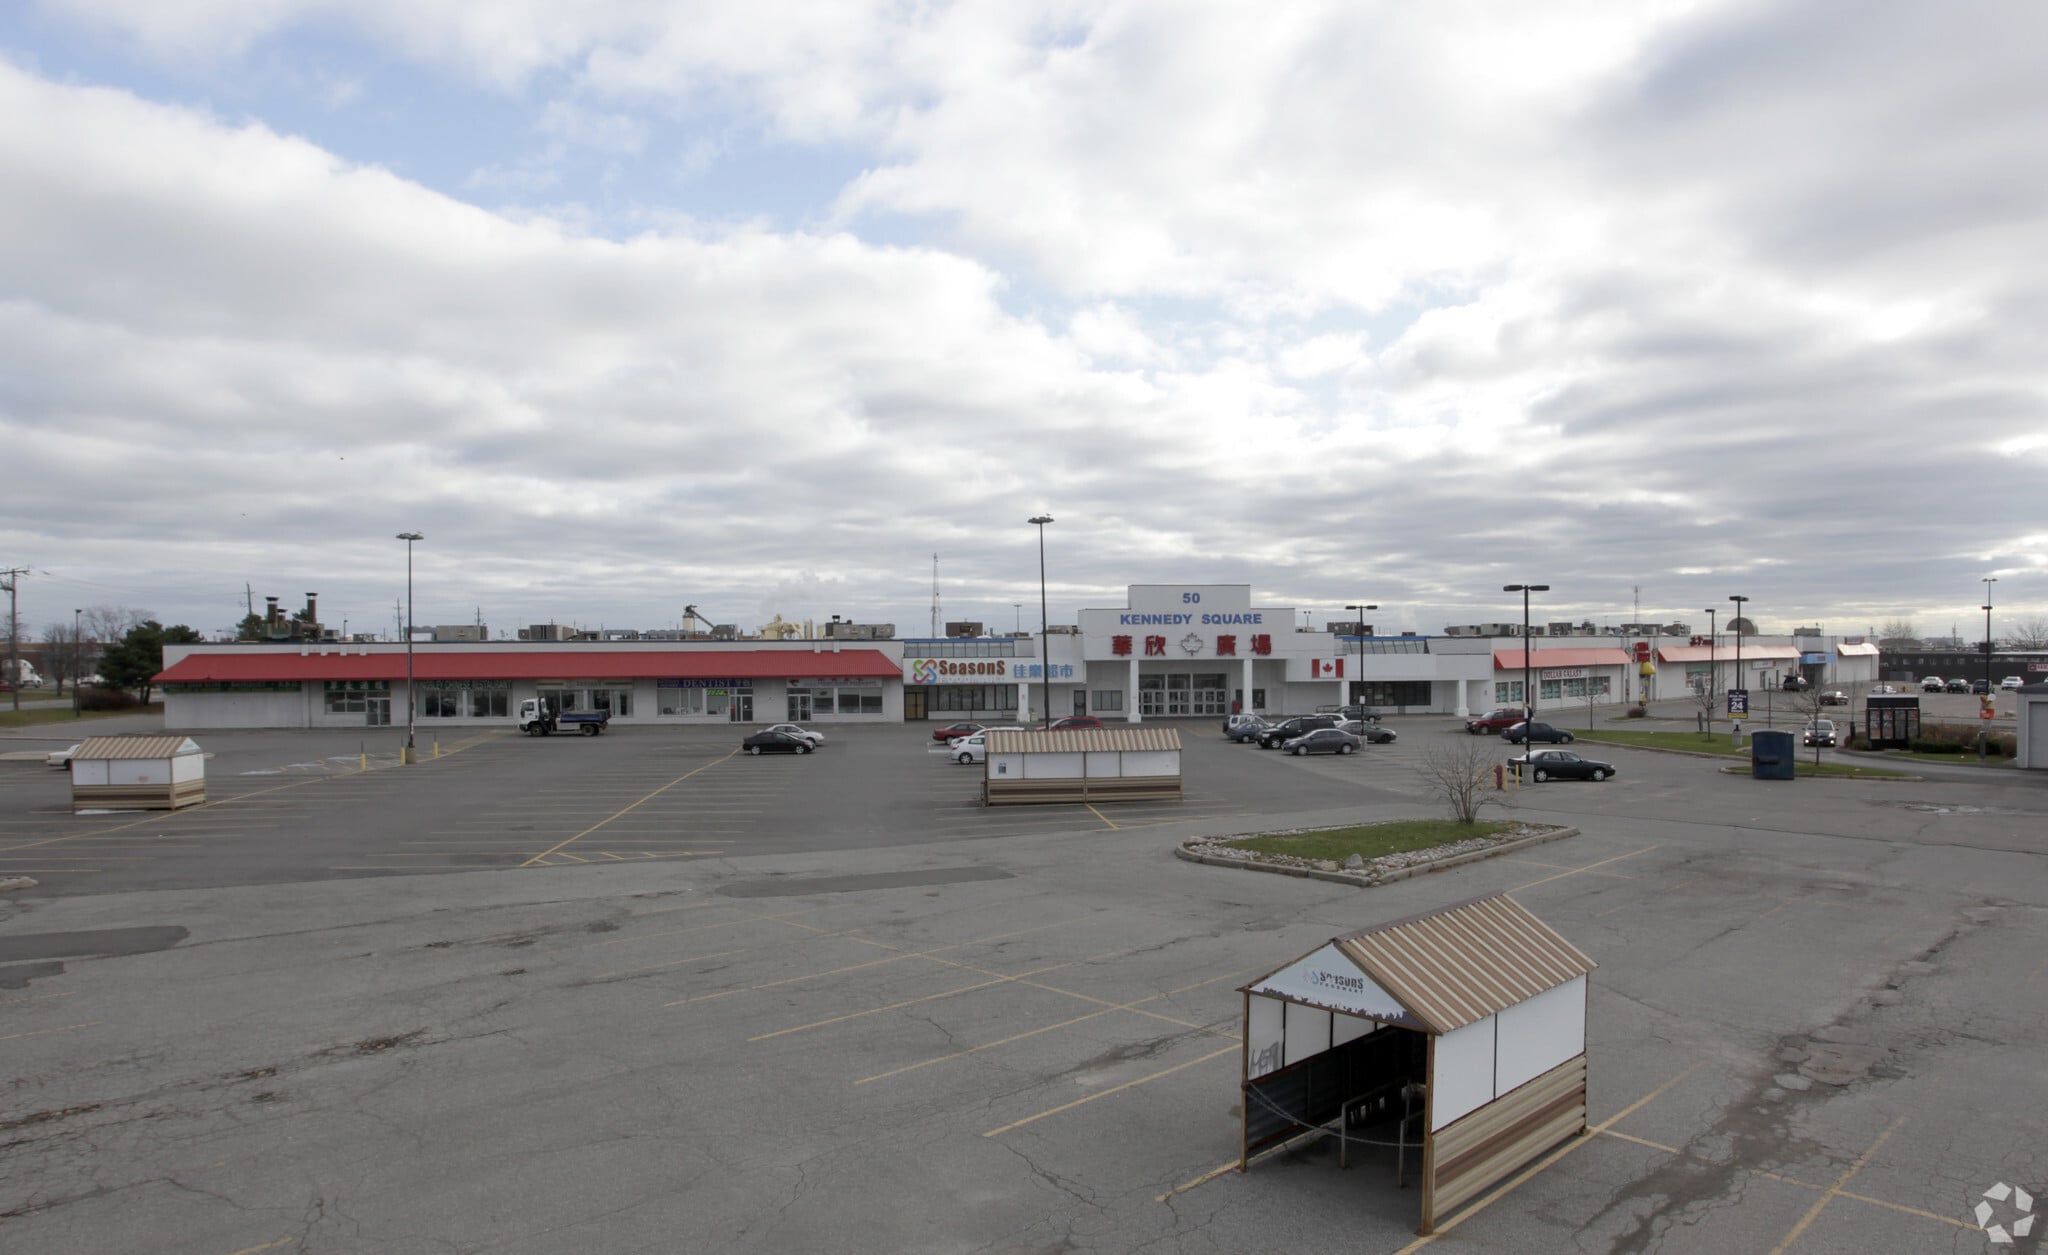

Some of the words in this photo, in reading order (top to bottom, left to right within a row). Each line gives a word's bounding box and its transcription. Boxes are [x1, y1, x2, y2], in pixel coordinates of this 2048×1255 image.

[1183, 593, 1200, 604] 50
[1120, 614, 1192, 625] KENNEDY
[1202, 613, 1262, 624] SQUARE
[683, 679, 731, 688] DENTIST
[1731, 701, 1743, 710] 24
